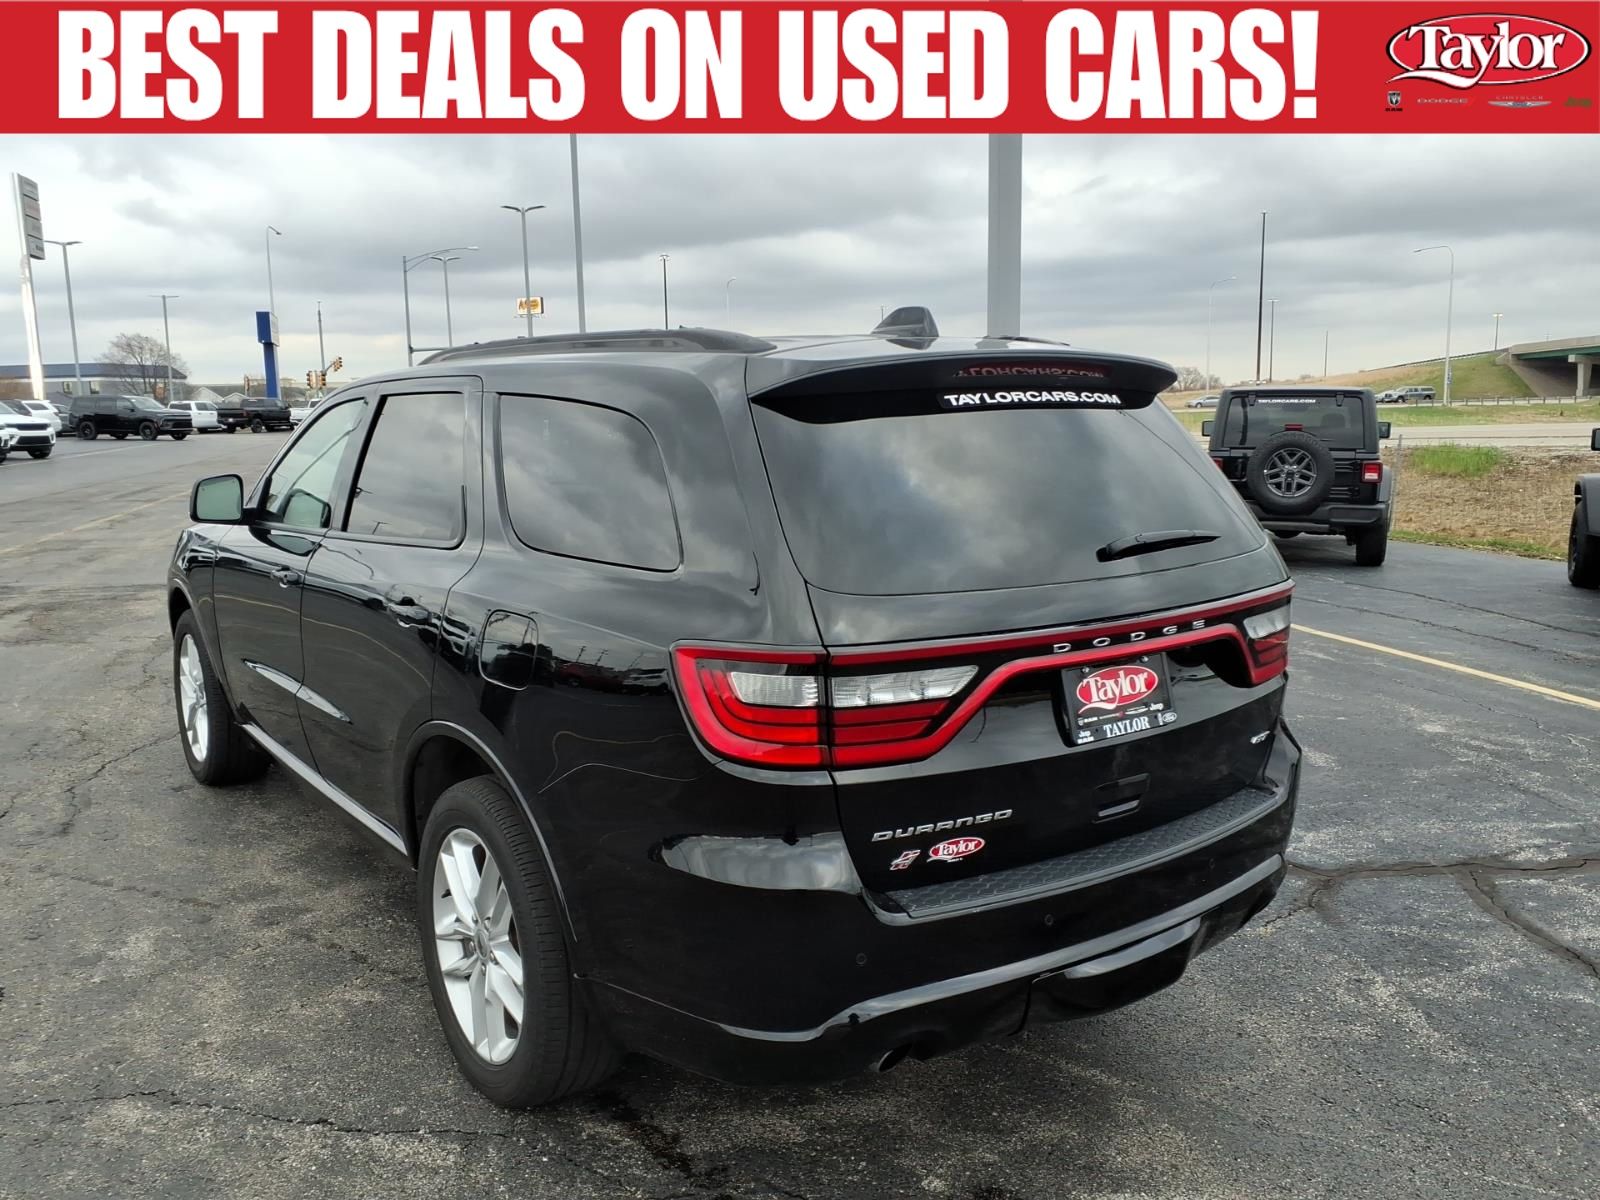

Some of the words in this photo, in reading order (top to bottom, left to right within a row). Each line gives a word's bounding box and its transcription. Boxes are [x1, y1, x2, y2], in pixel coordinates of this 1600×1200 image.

[943, 391, 1122, 405] TAYLORCARS.COM
[1053, 619, 1206, 653] DODGE
[1078, 670, 1148, 714] Taylor
[1103, 716, 1151, 738] TAYLOR
[871, 809, 1013, 842] DURANGO
[927, 840, 978, 863] Taylor
